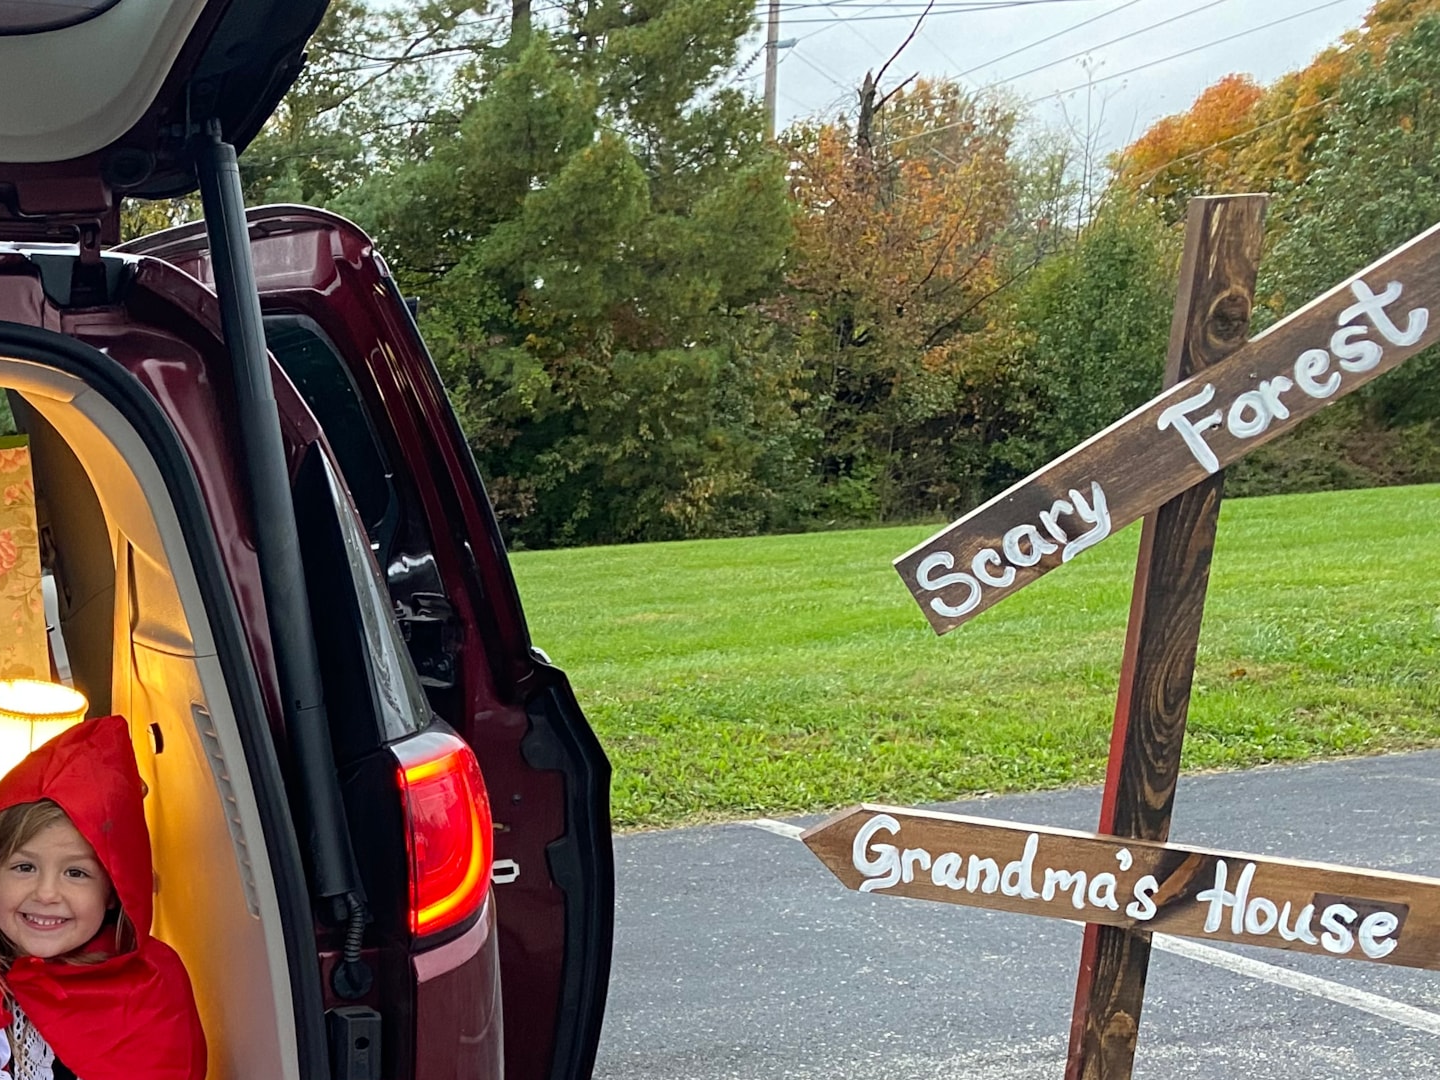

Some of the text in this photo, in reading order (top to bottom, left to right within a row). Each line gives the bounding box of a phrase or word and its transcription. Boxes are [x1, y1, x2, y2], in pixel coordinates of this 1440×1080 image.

[916, 280, 1429, 616] Scary Forest
[852, 814, 1399, 958] Grandma's House
